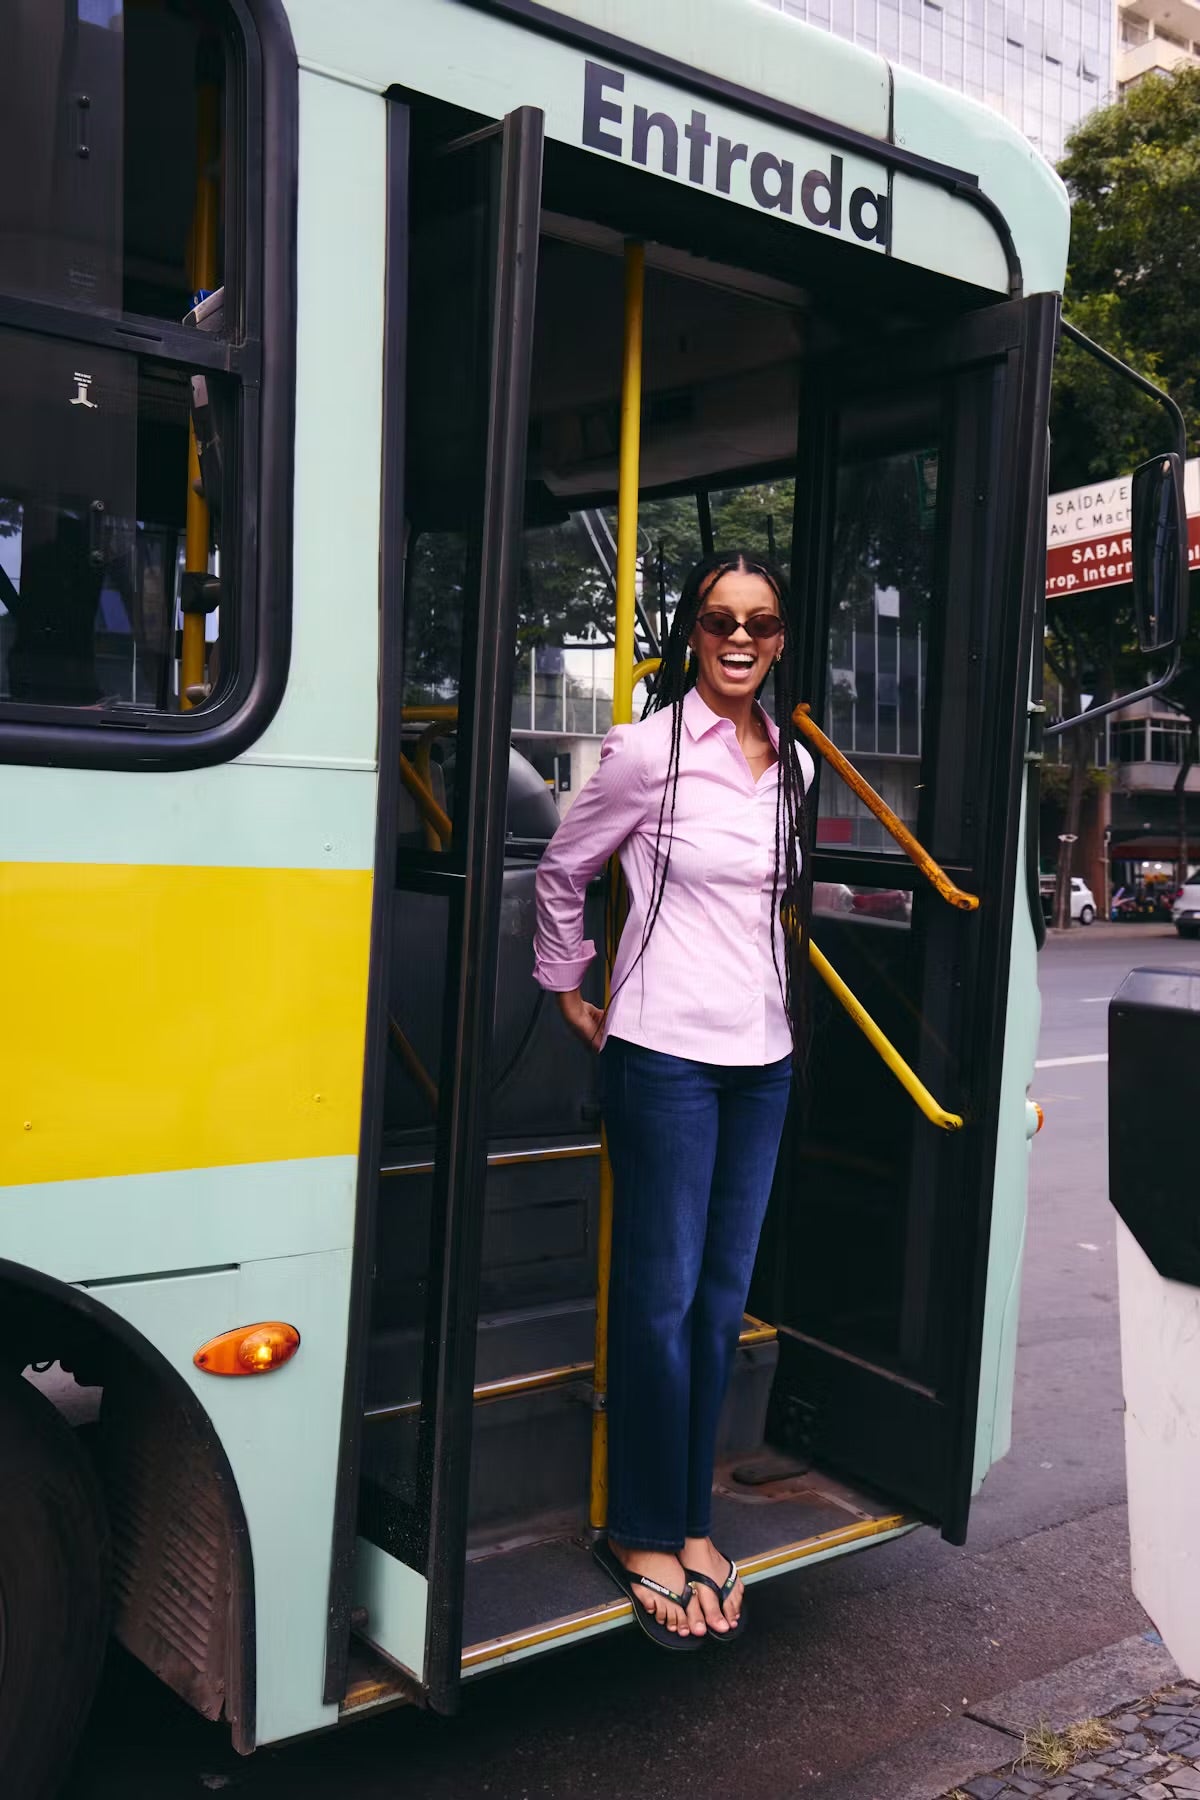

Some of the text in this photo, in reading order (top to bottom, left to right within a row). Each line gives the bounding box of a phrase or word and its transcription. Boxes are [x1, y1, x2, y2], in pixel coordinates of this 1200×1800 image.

[582, 59, 888, 245] Entrada
[1050, 524, 1067, 537] Av
[1075, 518, 1084, 530] C
